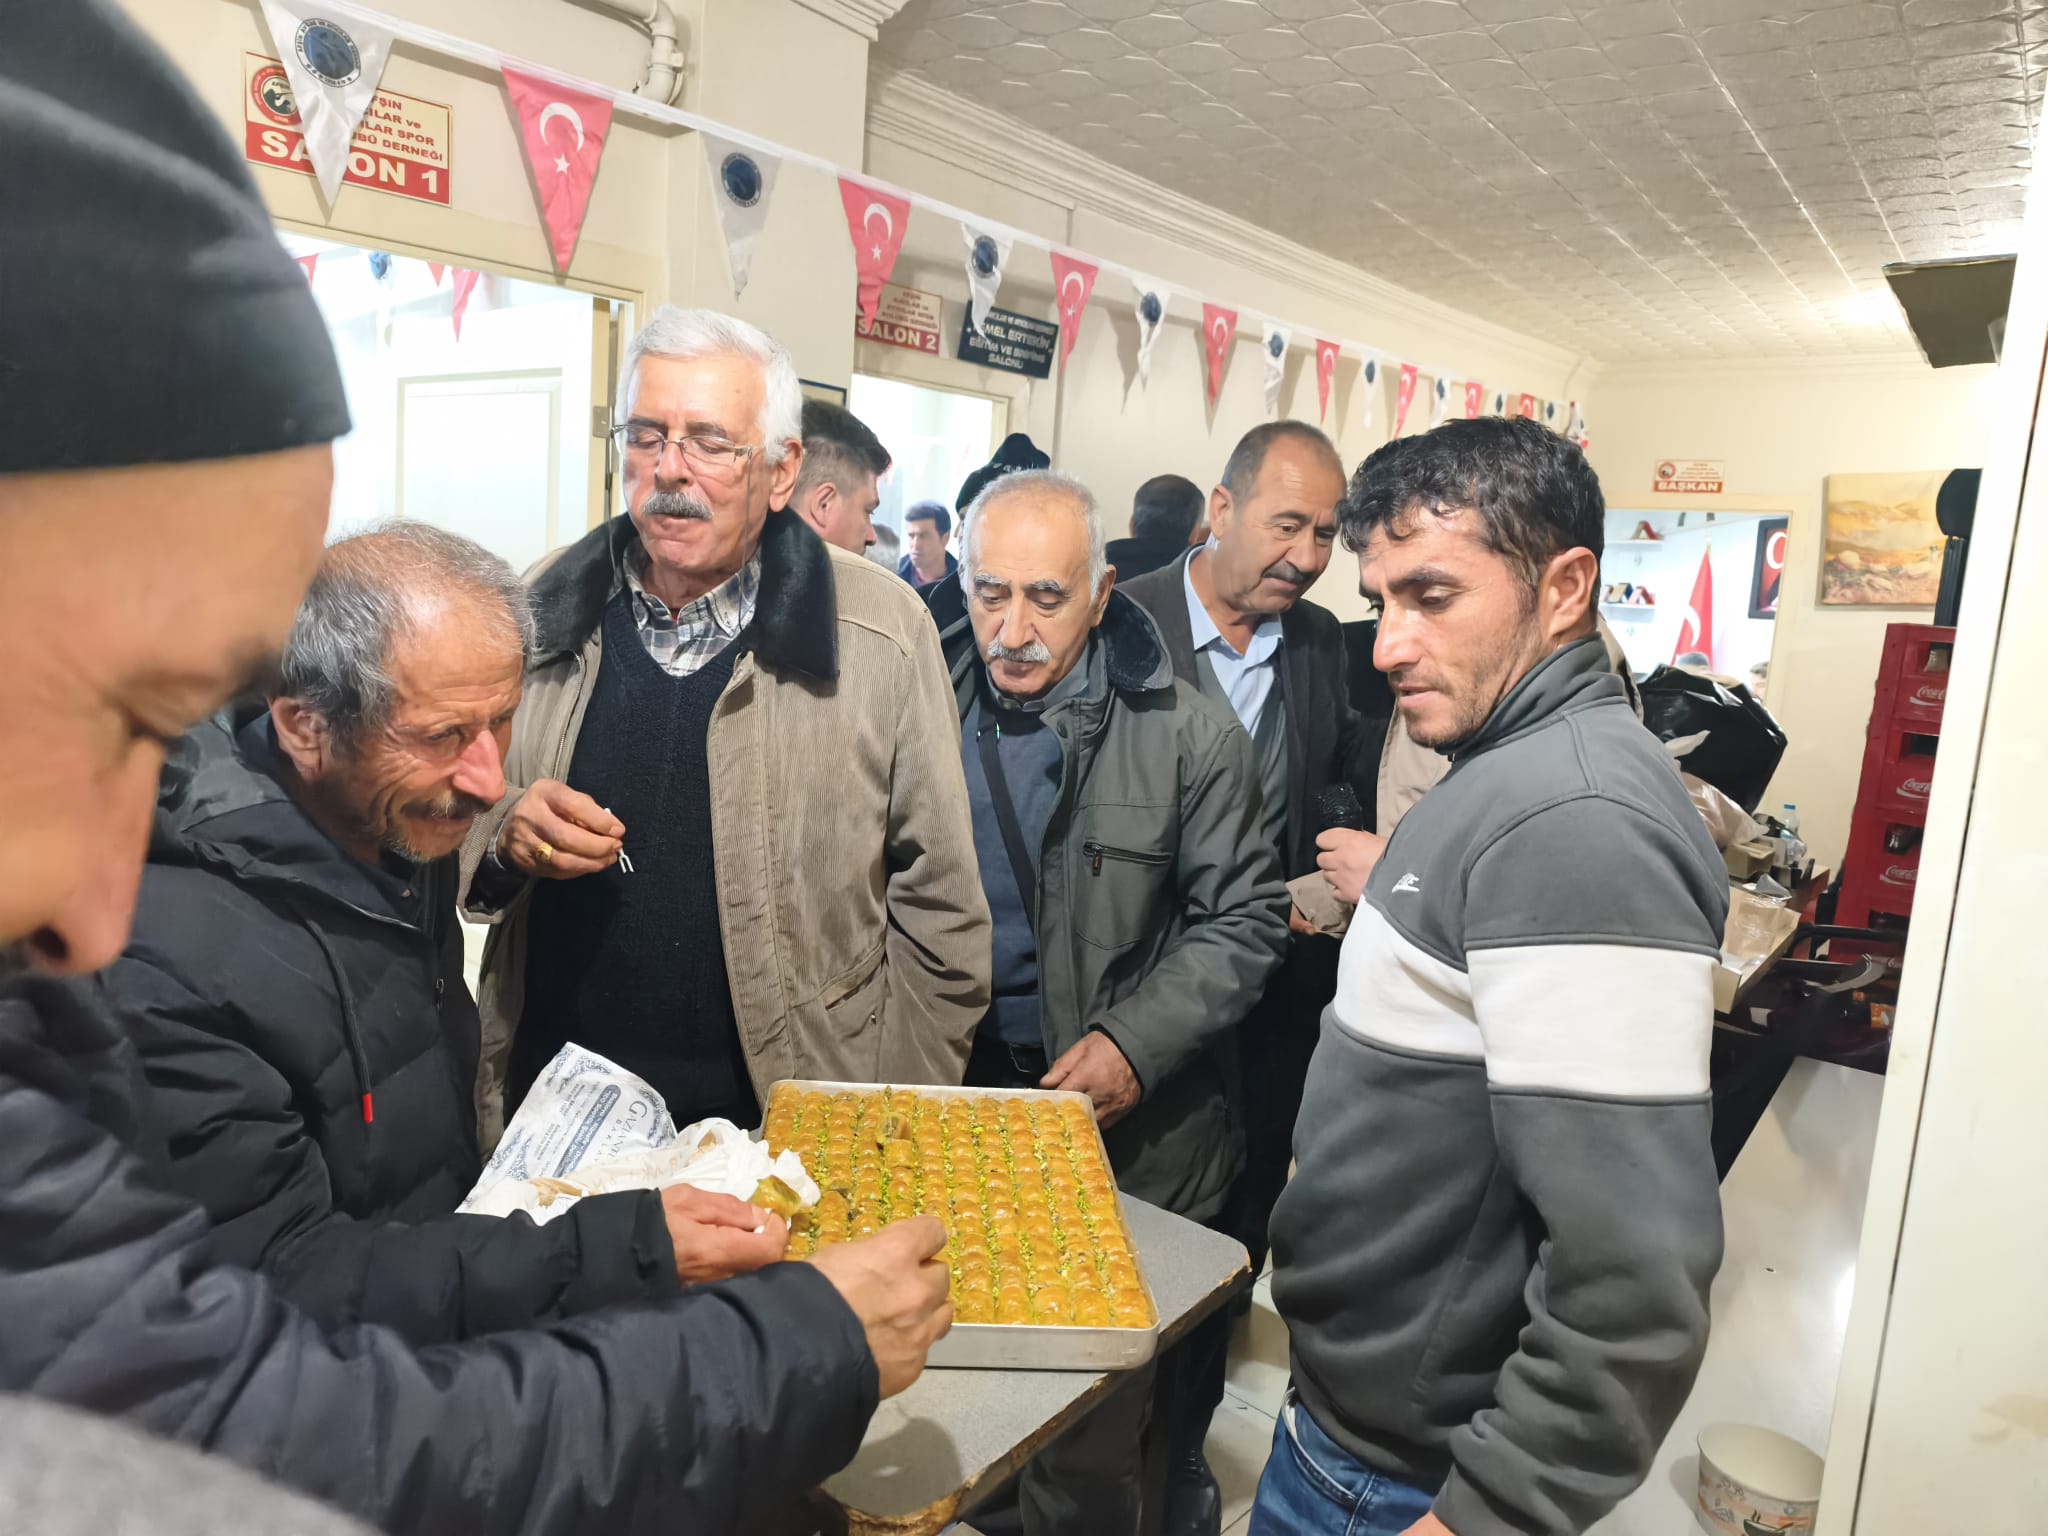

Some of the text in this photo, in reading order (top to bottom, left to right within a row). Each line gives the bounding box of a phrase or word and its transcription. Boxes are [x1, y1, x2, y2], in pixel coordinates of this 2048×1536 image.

[397, 129, 434, 146] SPOR
[260, 130, 438, 194] SAON 1
[857, 318, 937, 350] SALON 2
[1658, 482, 1719, 493] BAŞKAN
